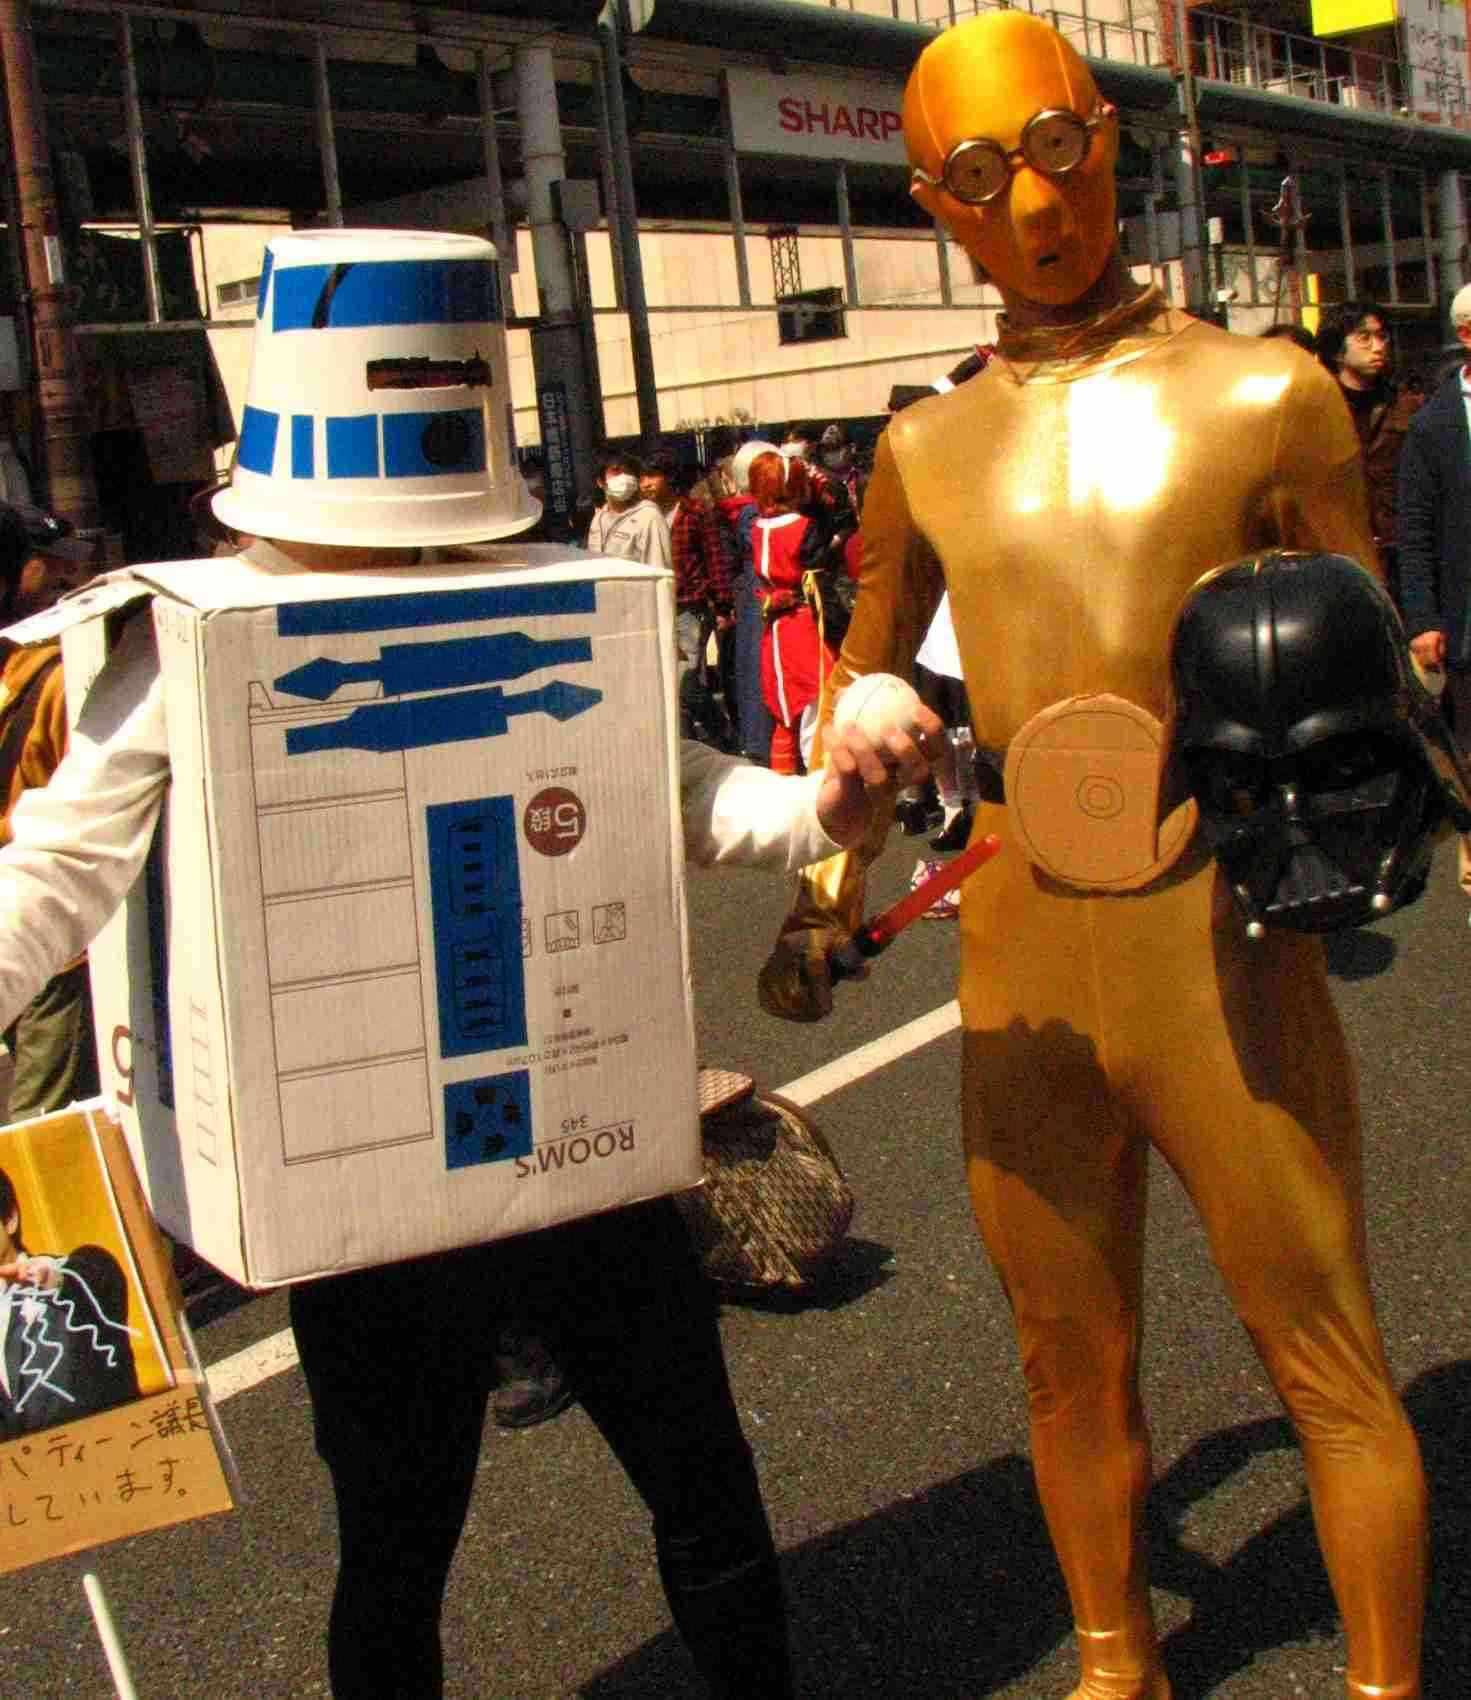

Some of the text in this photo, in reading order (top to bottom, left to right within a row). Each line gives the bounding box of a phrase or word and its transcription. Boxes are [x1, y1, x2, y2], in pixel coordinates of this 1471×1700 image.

[778, 98, 903, 141] SHARP
[528, 803, 579, 839] 5段
[514, 1124, 634, 1178] ROOM'S
